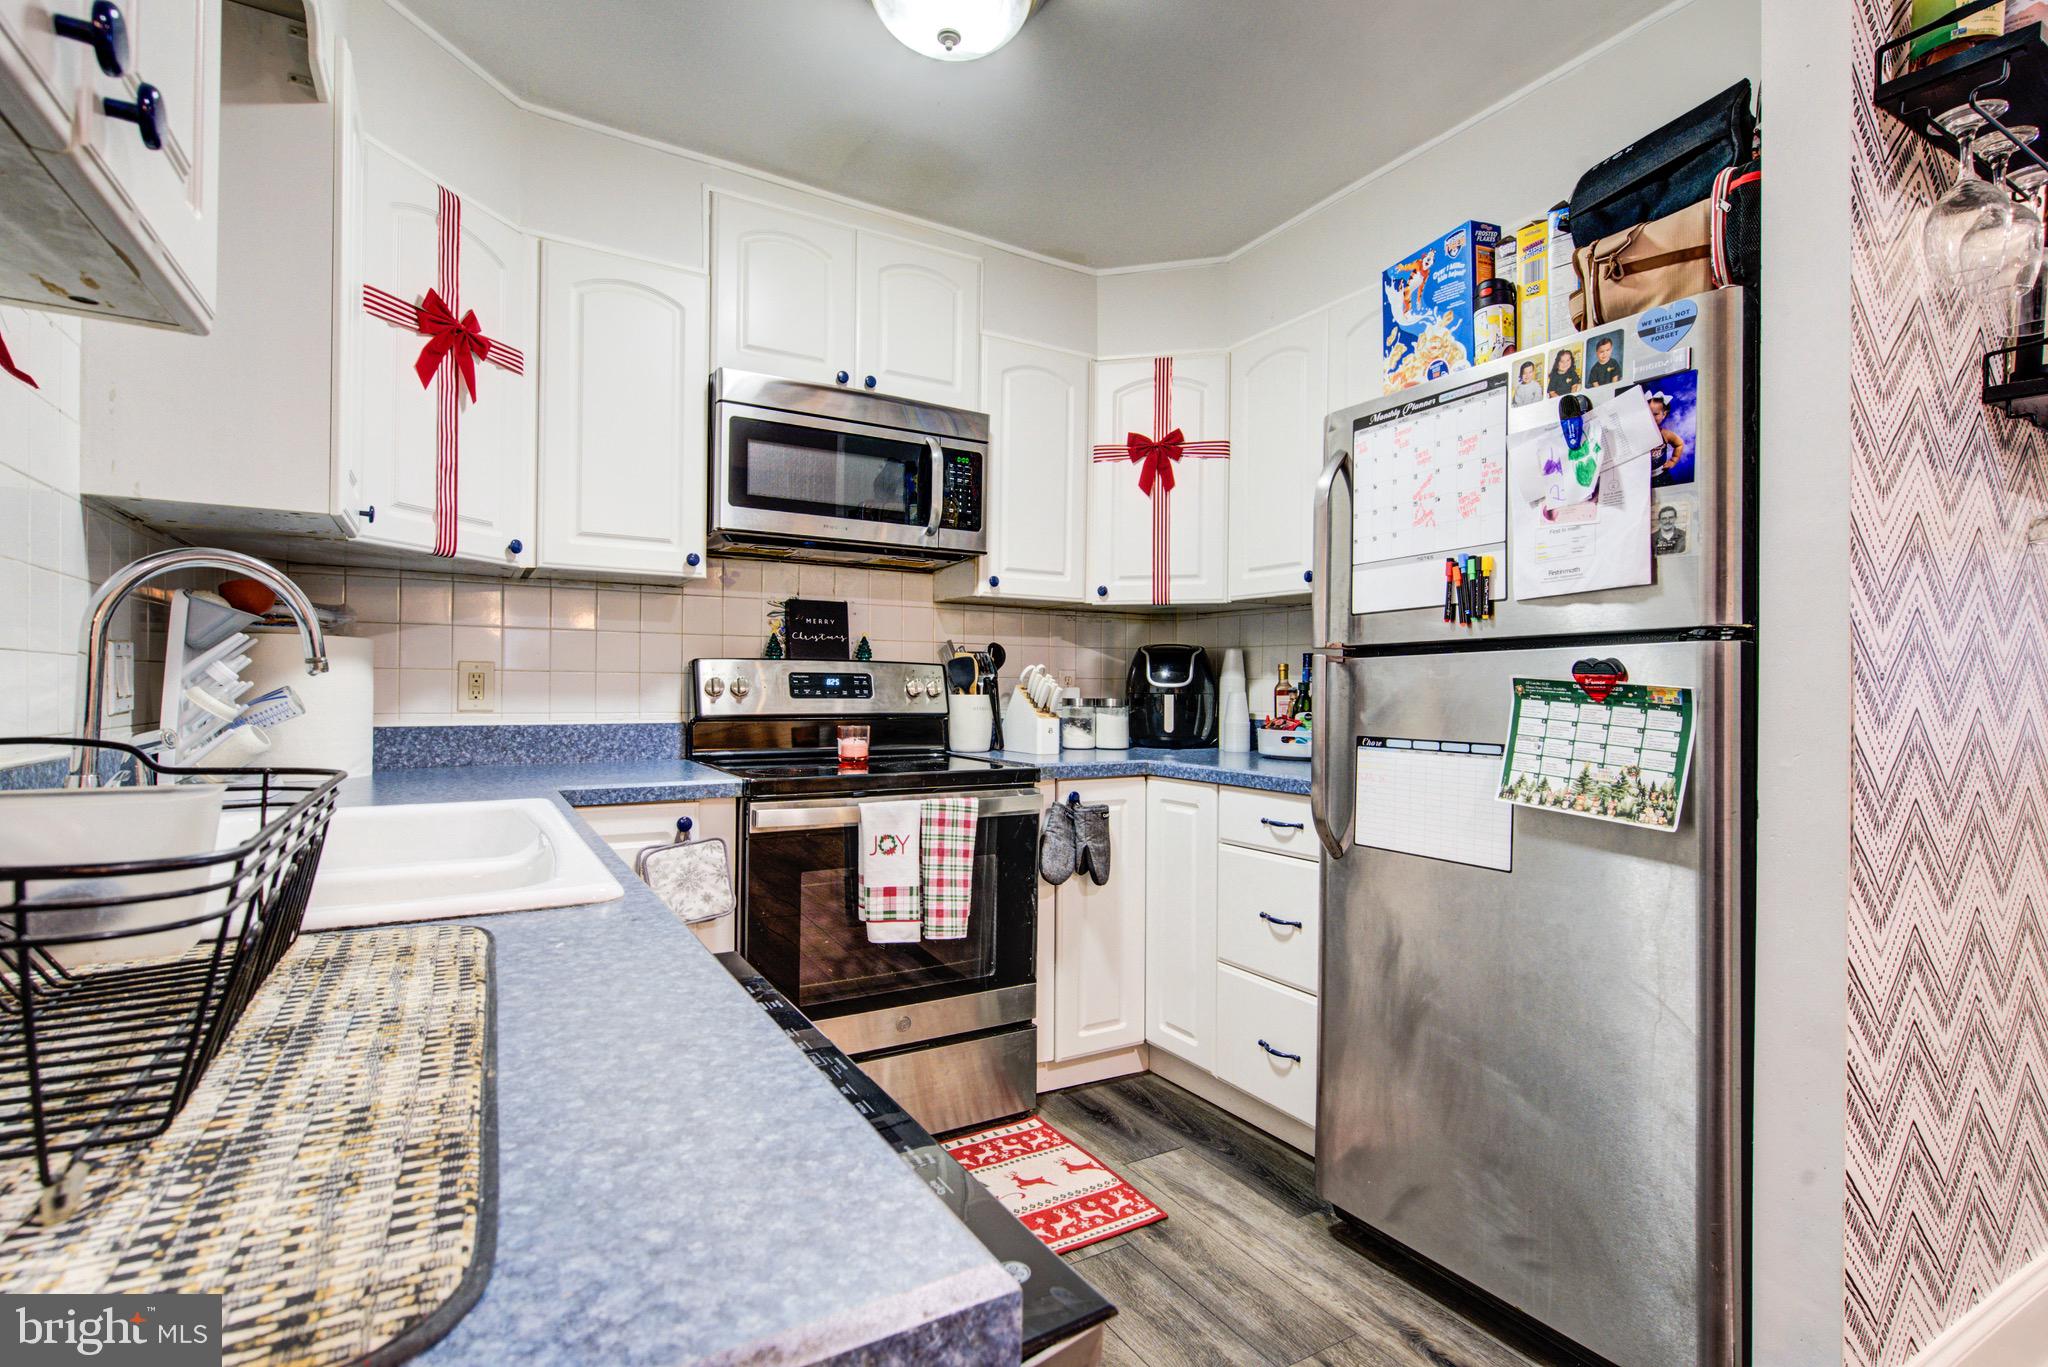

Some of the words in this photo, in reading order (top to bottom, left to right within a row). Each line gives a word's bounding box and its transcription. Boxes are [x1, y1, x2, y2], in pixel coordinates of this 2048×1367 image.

[1655, 314, 1673, 323] WILL
[1675, 308, 1691, 318] NOT
[1650, 330, 1679, 342] FORGET
[1368, 408, 1401, 425] Monthly
[1402, 398, 1436, 417] Planner
[1362, 737, 1382, 747] Chore
[869, 834, 910, 856] JOY
